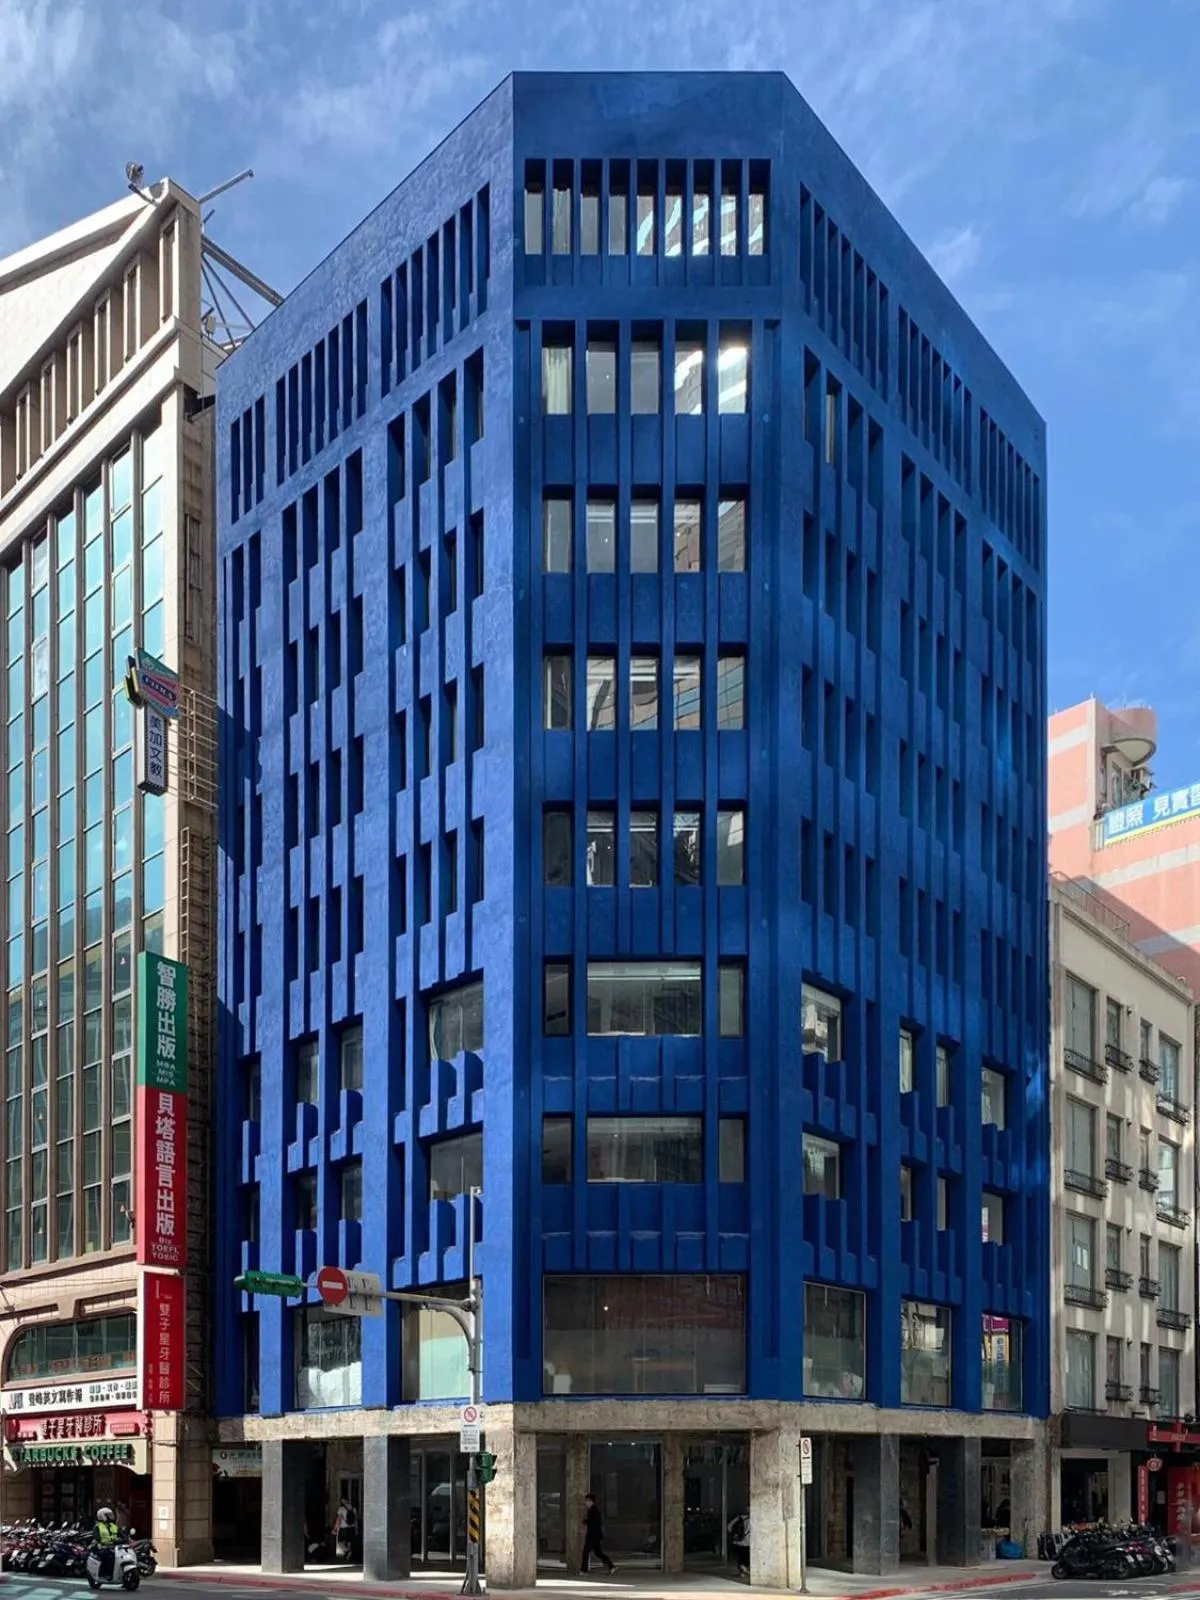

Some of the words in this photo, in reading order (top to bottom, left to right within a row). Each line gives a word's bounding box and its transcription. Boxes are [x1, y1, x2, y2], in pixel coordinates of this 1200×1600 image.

[149, 715, 163, 779] 美加文教
[156, 960, 177, 1060] 智勝出版
[155, 1092, 175, 1237] 貝塔語言出版
[83, 1444, 128, 1460] COFFEE
